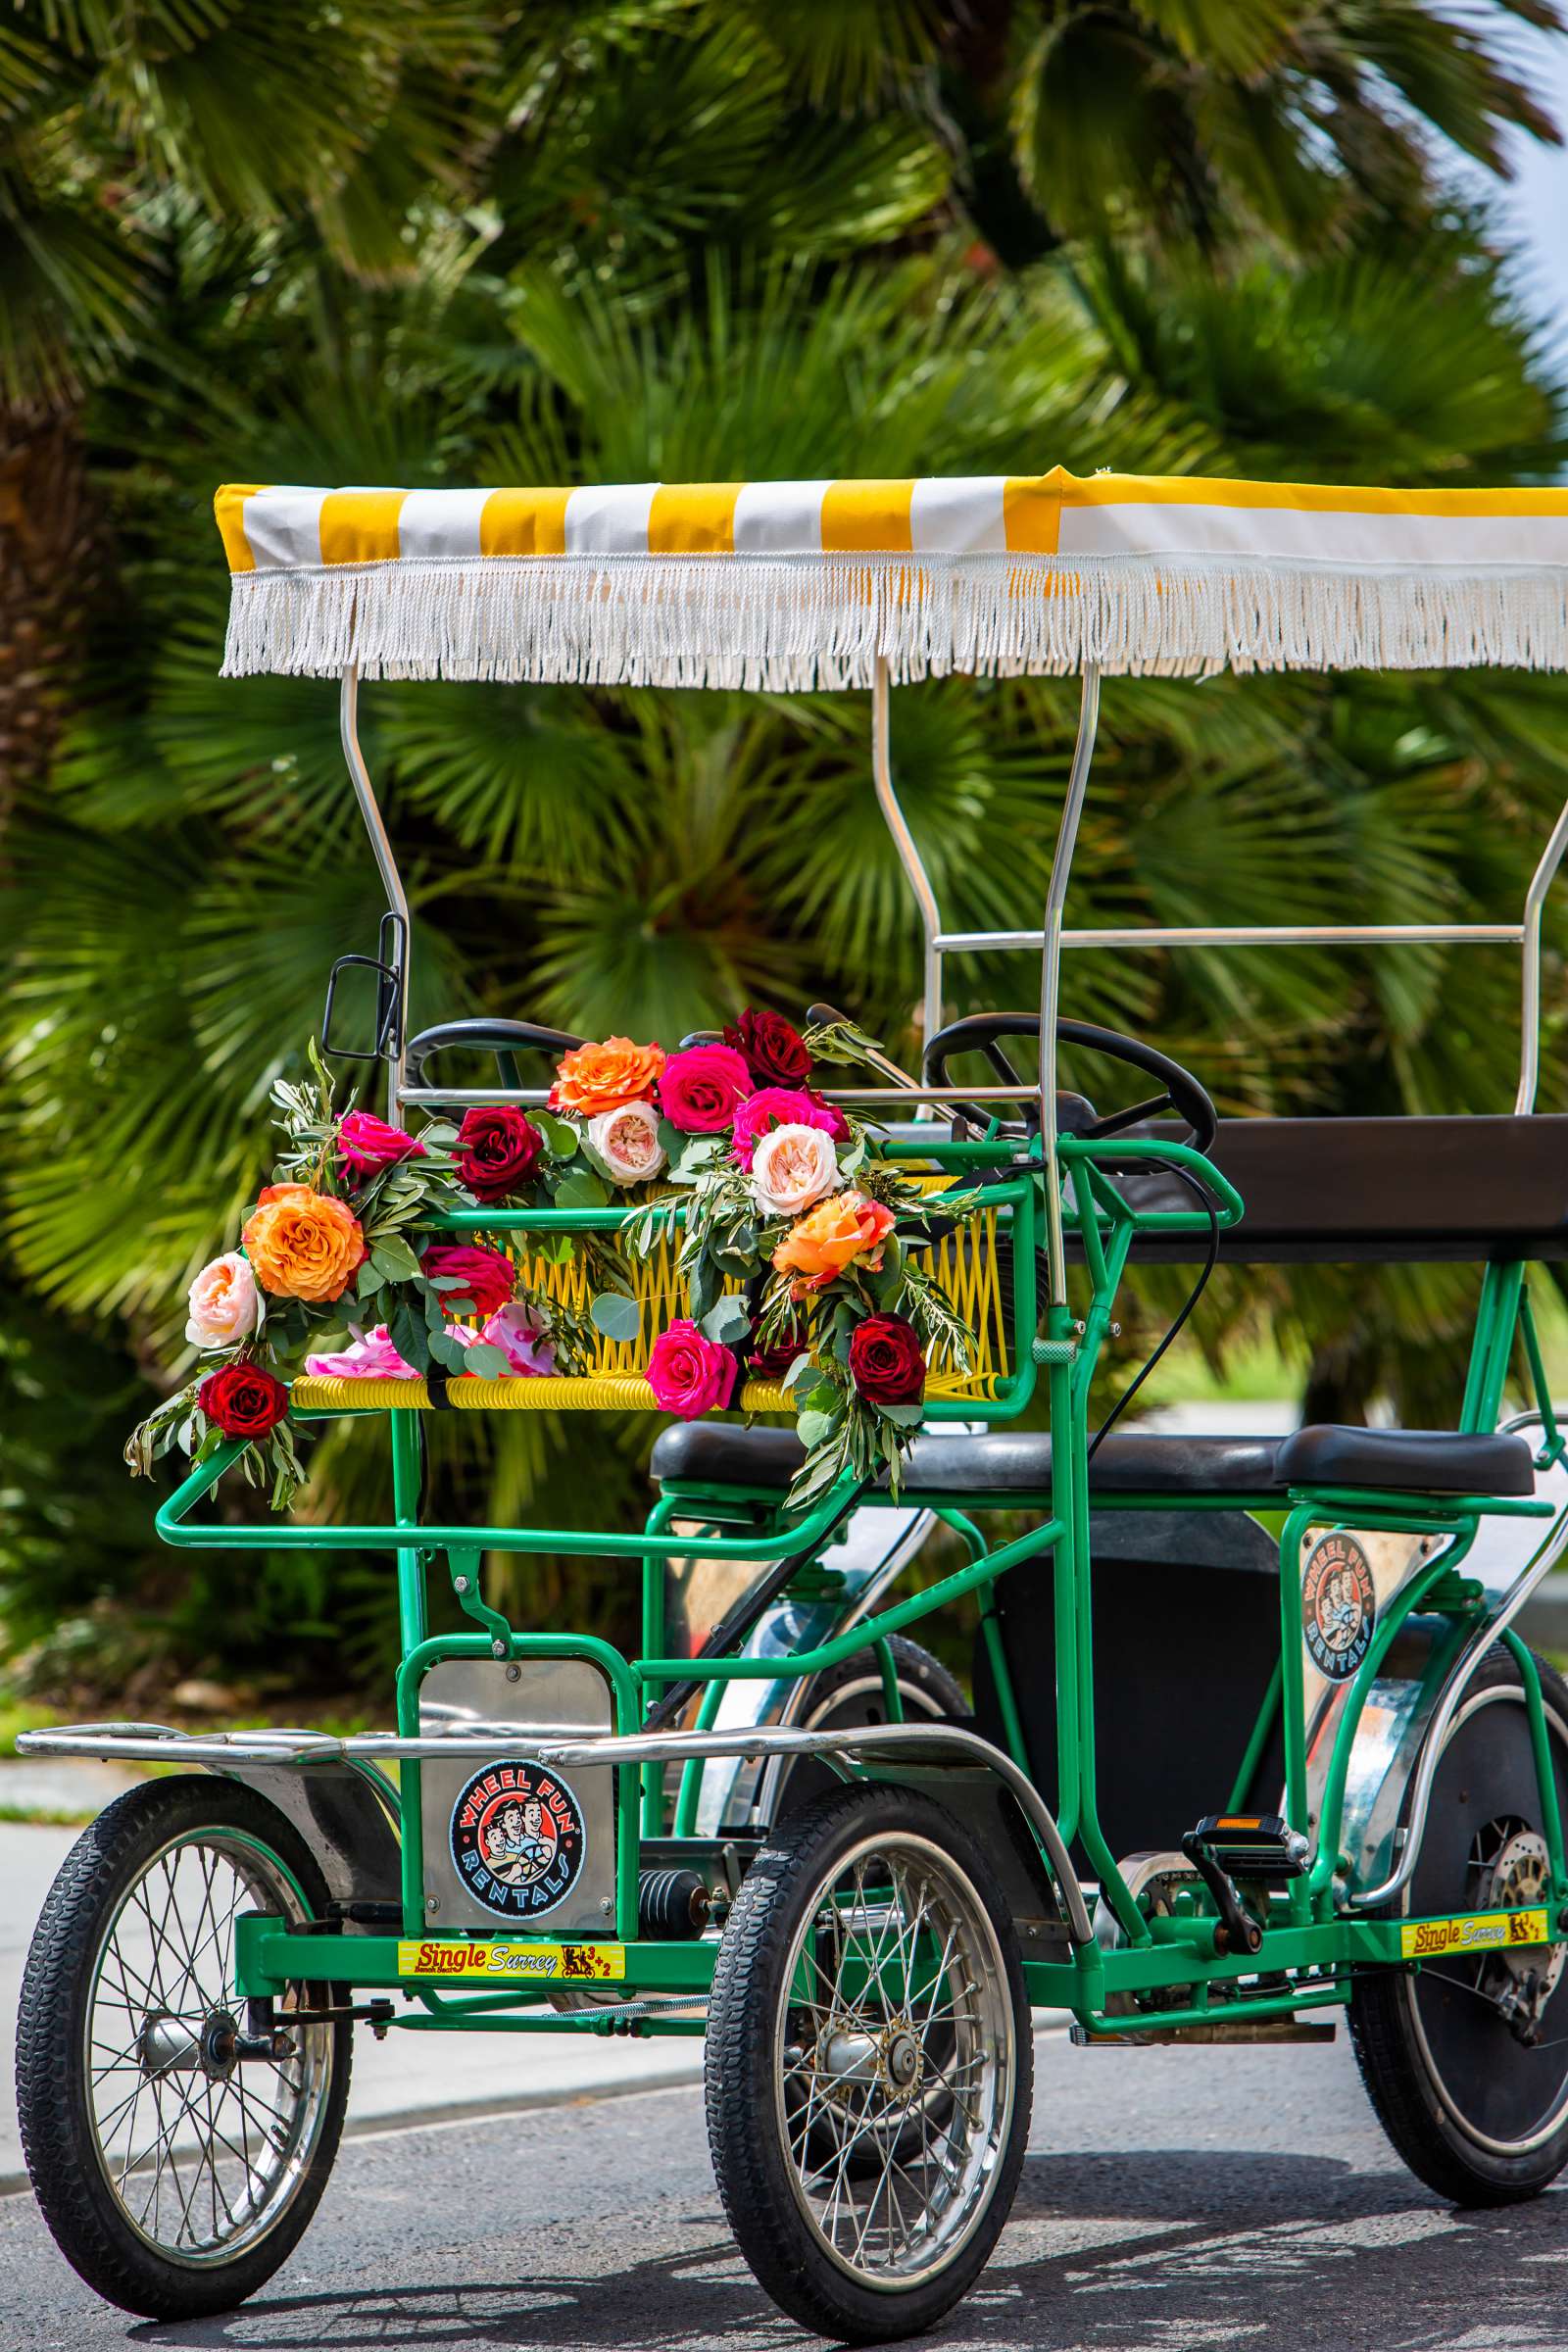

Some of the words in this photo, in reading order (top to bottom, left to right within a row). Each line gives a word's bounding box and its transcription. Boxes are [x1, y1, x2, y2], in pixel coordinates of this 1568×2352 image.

[1304, 1540, 1346, 1601] WHEEL
[1348, 1547, 1371, 1597] FUN
[1306, 1615, 1370, 1672] RENTALS
[460, 1769, 531, 1828] WHEEL
[536, 1779, 575, 1834] FUN
[461, 1852, 567, 1908] RENTALS
[418, 1943, 486, 1973] Single
[487, 1946, 558, 1977] Surrey
[1415, 1920, 1460, 1950] Single
[1461, 1921, 1505, 1945] Surrey
